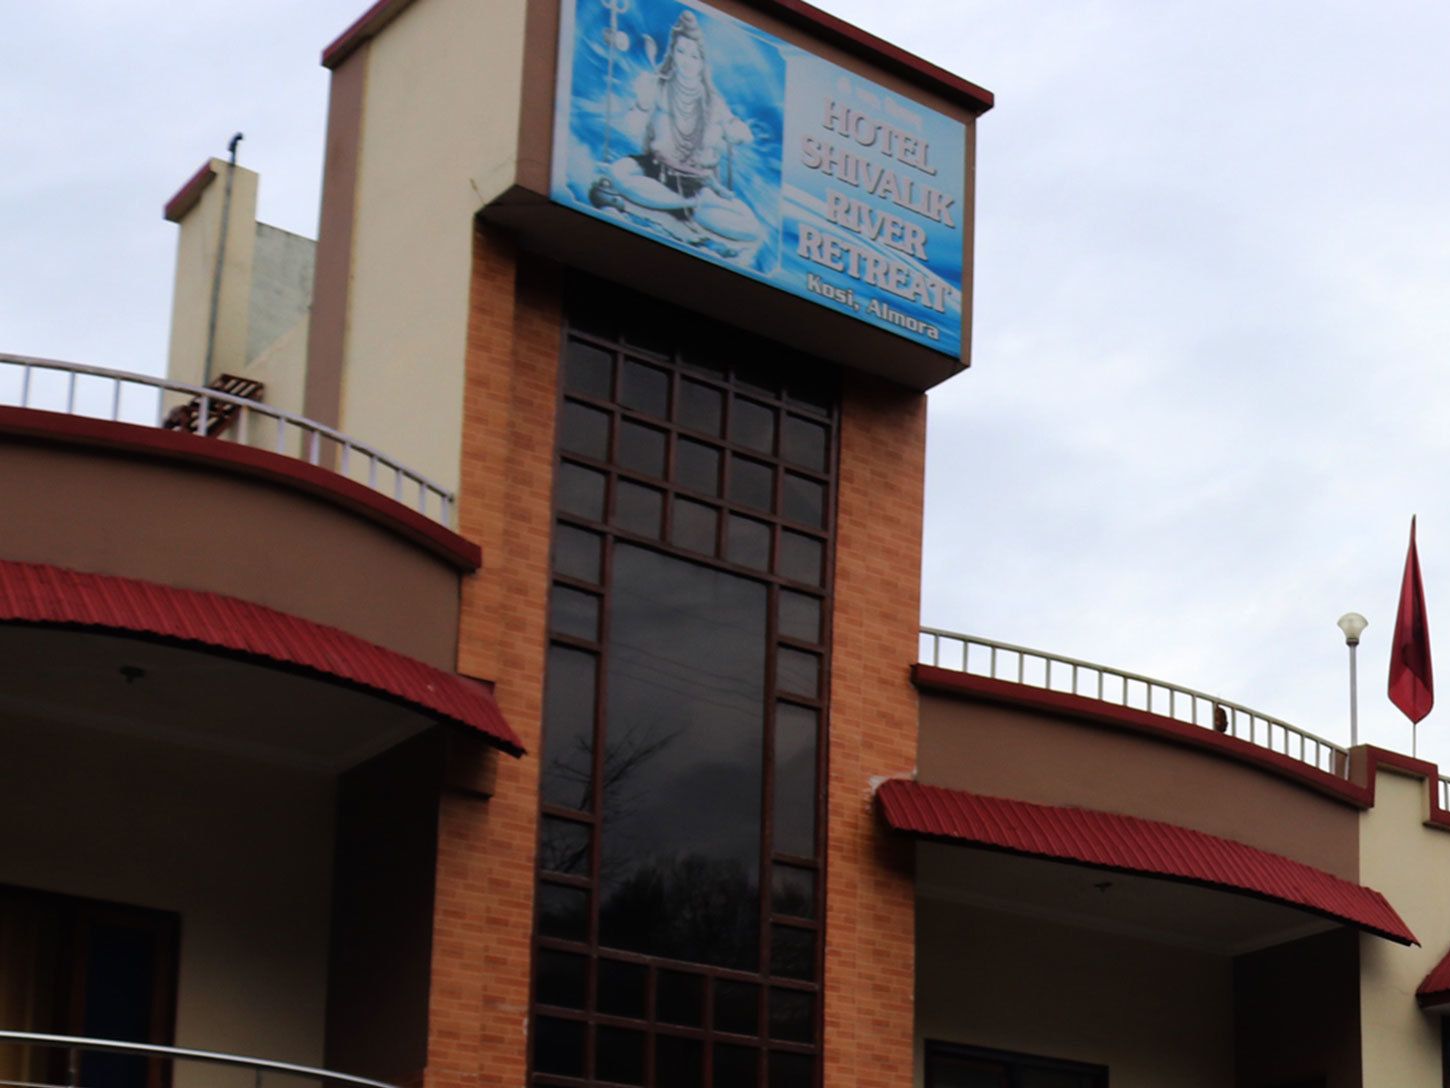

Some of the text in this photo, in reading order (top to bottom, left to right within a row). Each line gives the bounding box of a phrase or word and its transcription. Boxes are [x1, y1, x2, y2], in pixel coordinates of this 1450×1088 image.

[822, 95, 937, 175] HOTEL
[800, 133, 956, 229] SHIVALIK
[825, 188, 928, 261] RIVER
[797, 222, 952, 314] RETREAT
[806, 273, 940, 340] Kosi, Almora
